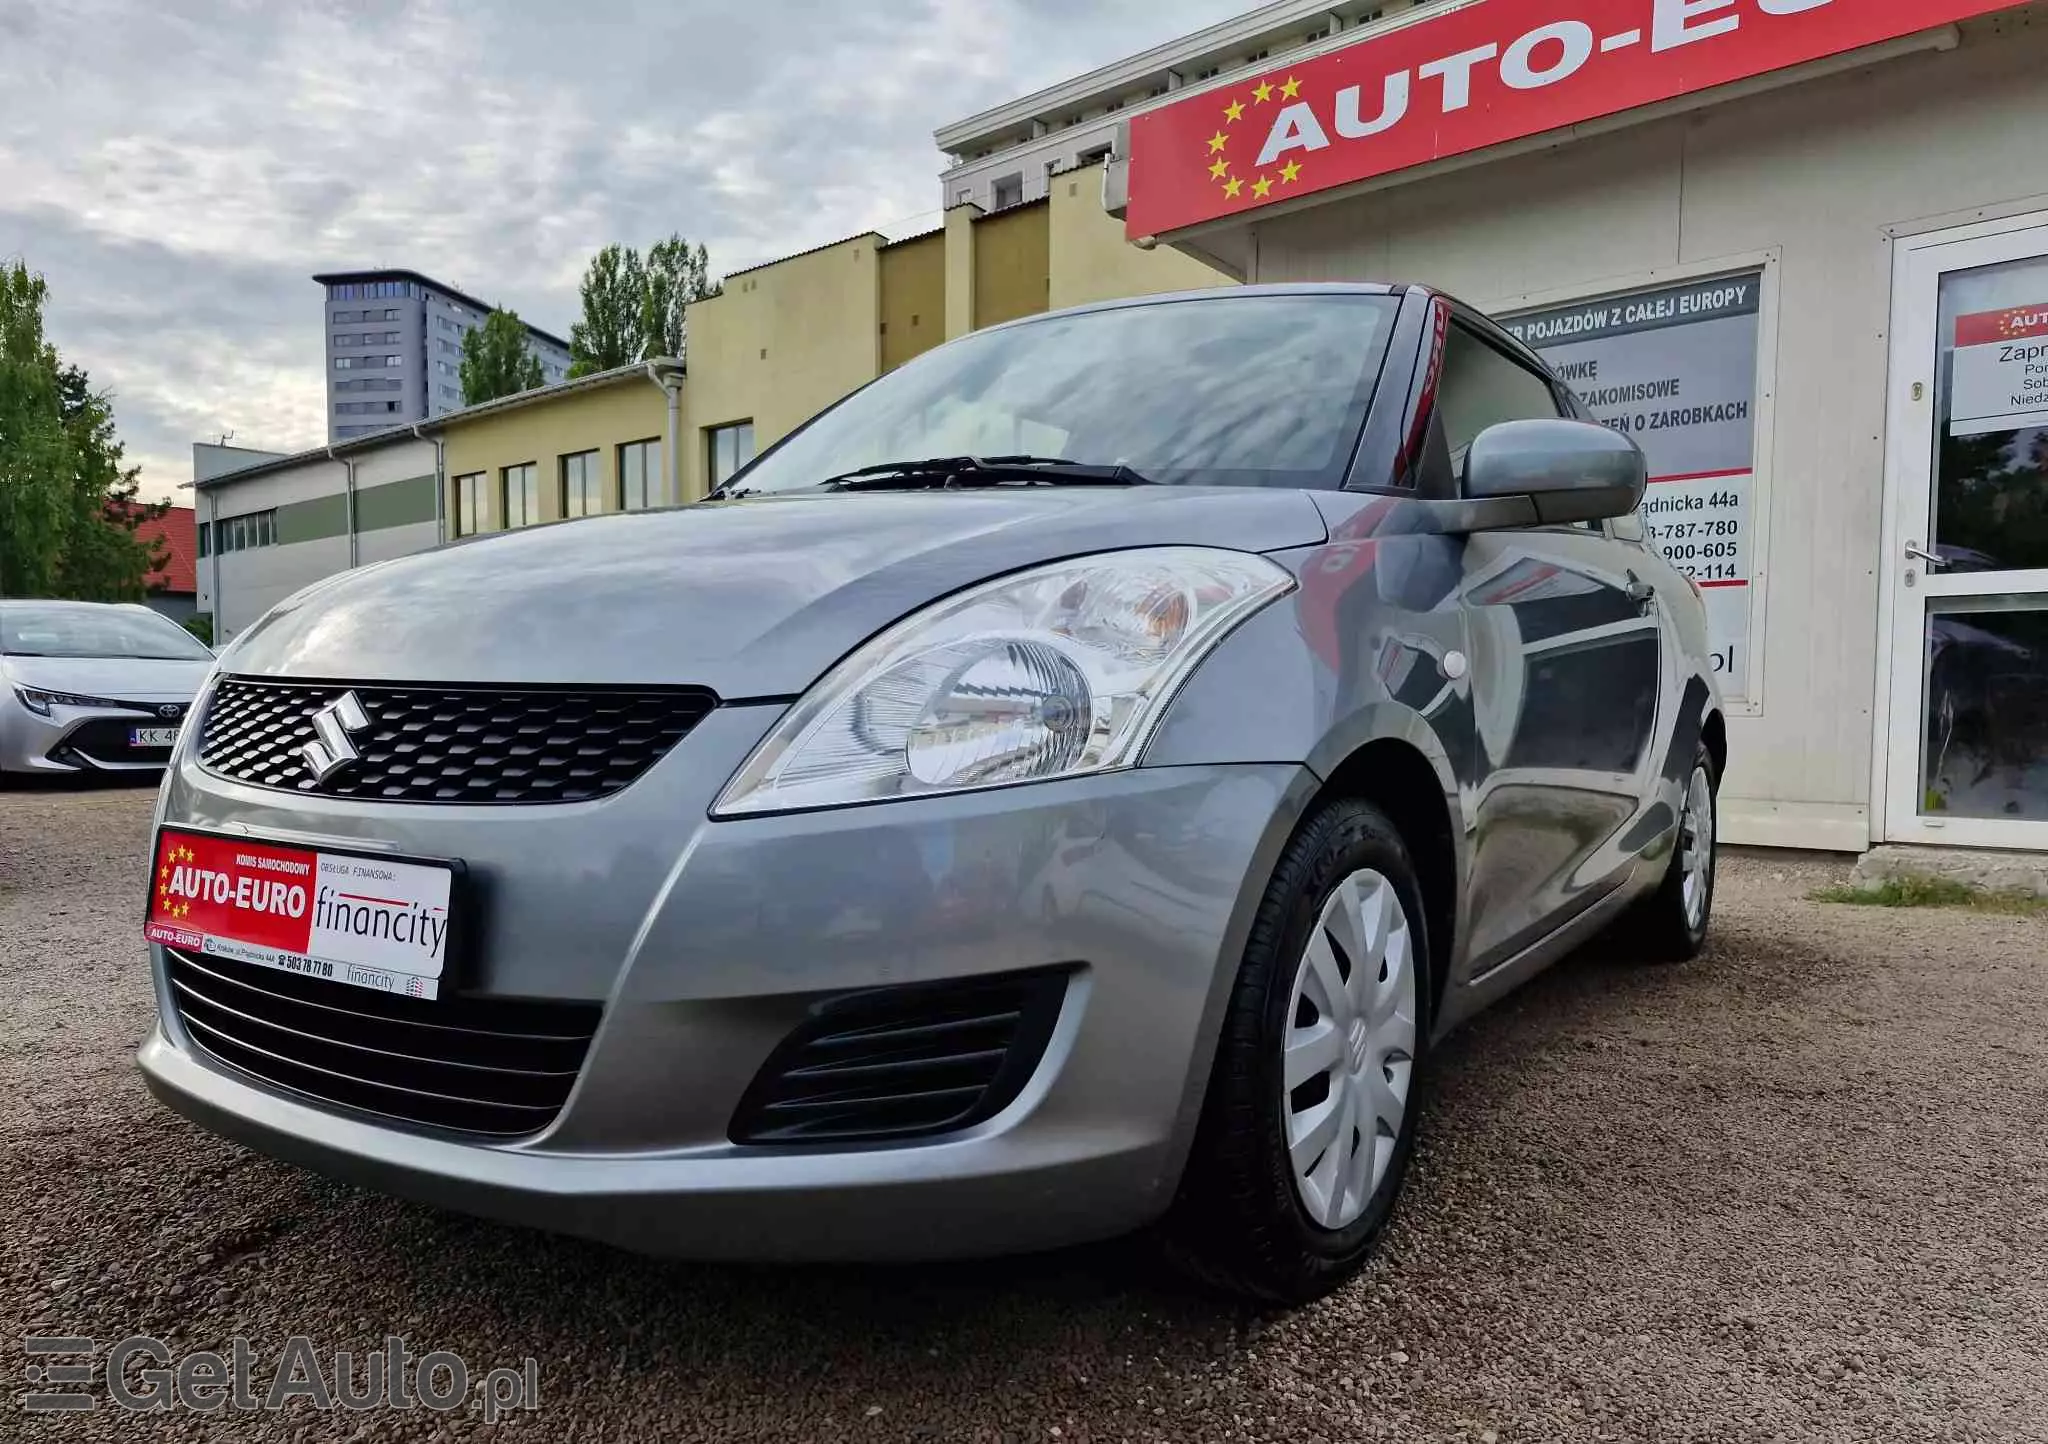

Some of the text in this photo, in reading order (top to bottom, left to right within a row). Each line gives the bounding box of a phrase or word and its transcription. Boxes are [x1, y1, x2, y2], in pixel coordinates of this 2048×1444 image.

[1254, 0, 1832, 167] AUTO-E
[1527, 309, 1607, 340] POJAZDÓW
[1611, 308, 1621, 326] Z
[1625, 298, 1675, 323] CAŁEJ
[1679, 285, 1747, 314] EUROPY
[1634, 414, 1645, 431] O
[1649, 400, 1747, 430] ZAROBKACH
[1708, 491, 1738, 509] 44a
[1663, 541, 1737, 560] 900-605
[1677, 563, 1737, 579] 2-114
[257, 857, 310, 876] SAMOCHODOWY
[169, 866, 306, 918] AUTO-EURO
[316, 886, 449, 958] financity
[151, 928, 200, 947] AUTO-EURO
